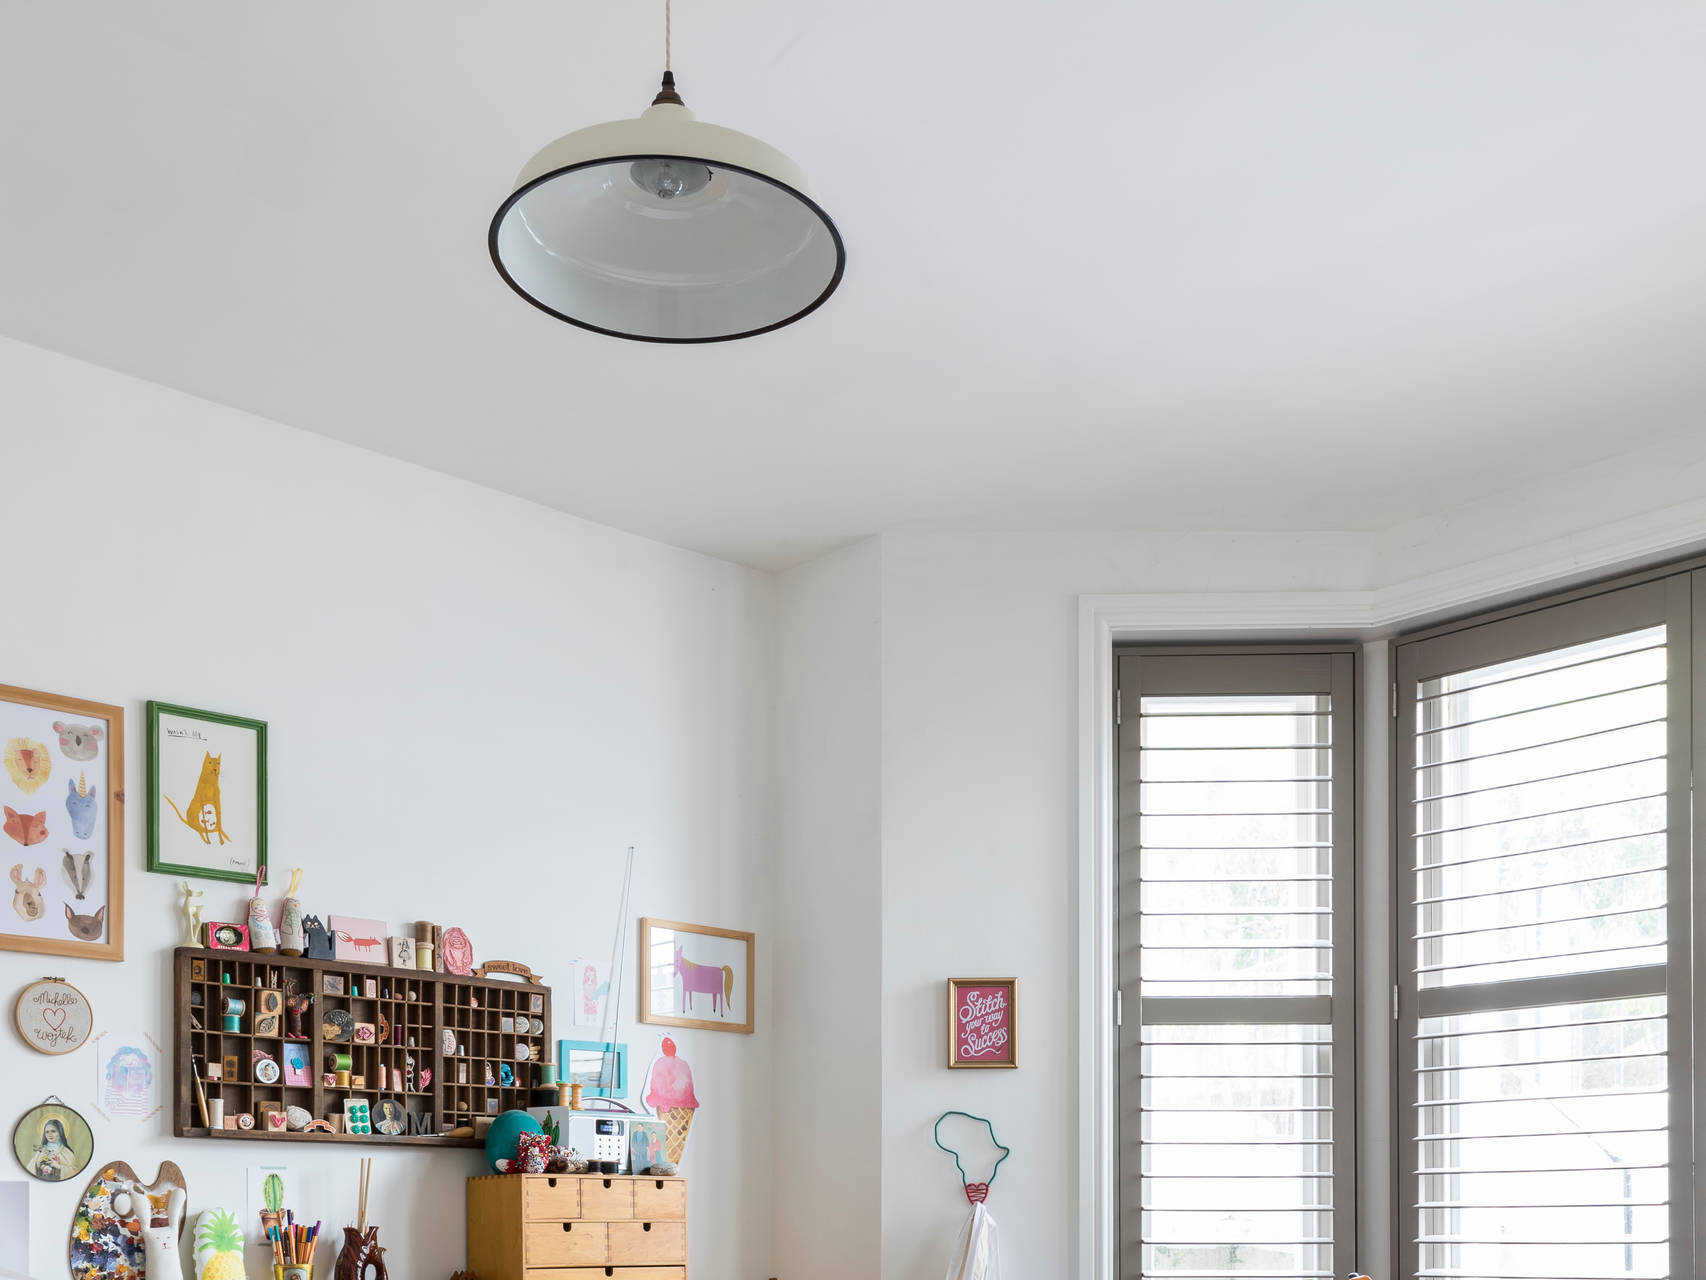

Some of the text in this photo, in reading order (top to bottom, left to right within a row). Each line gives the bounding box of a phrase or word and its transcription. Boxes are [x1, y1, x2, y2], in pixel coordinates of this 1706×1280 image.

[487, 961, 528, 974] sweet love
[33, 990, 77, 1006] Michelle
[960, 991, 1007, 1023] Stitch
[961, 1011, 1003, 1038] your way
[980, 1023, 990, 1034] to
[961, 1027, 1007, 1057] Success
[409, 1111, 432, 1136] M
